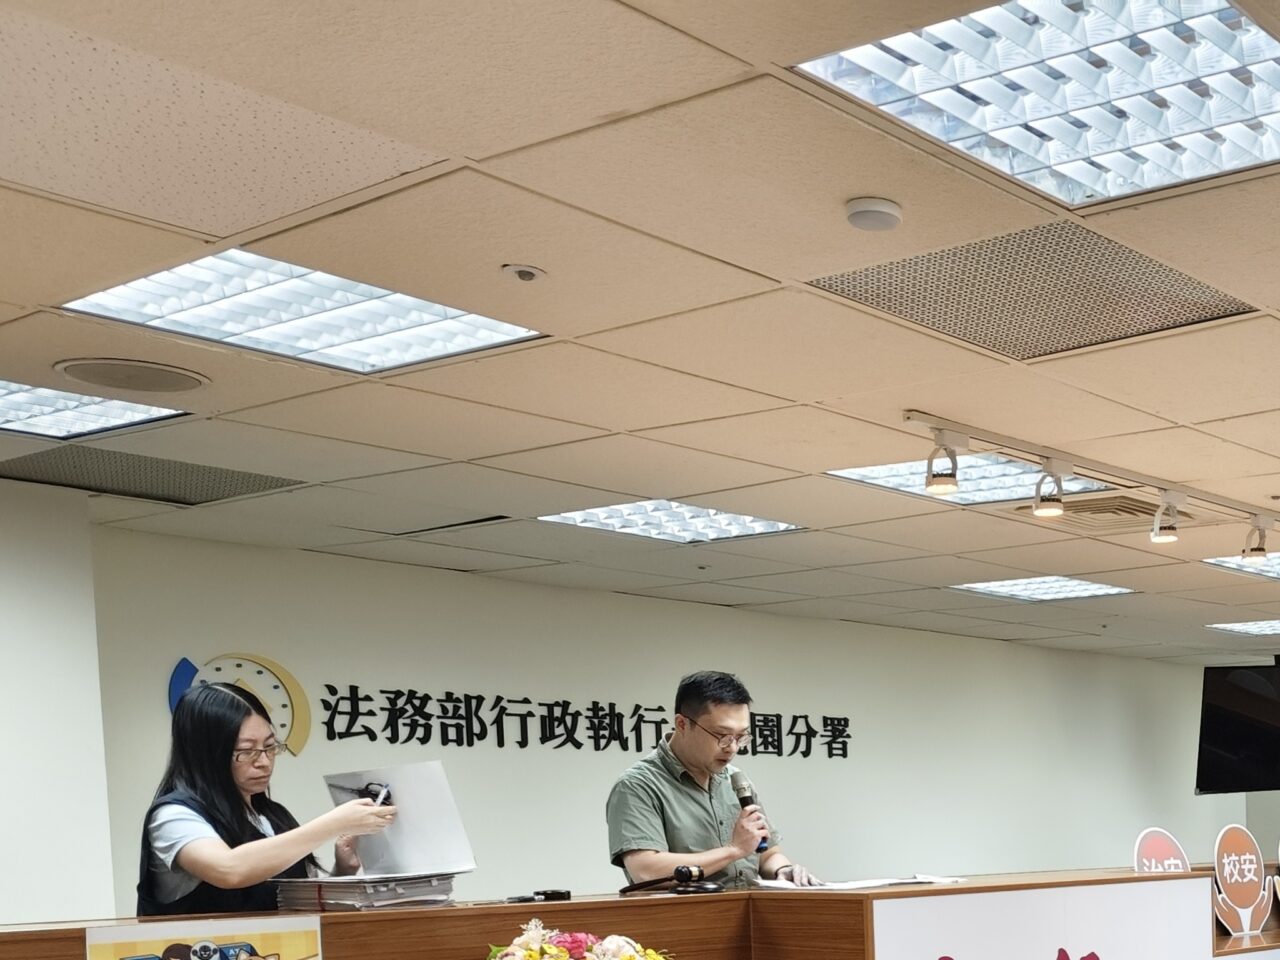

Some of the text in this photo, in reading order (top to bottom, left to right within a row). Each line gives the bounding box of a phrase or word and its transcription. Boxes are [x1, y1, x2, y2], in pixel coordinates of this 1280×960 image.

[320, 682, 852, 759] 法務部行政執行園分署
[1222, 853, 1259, 884] 校安
